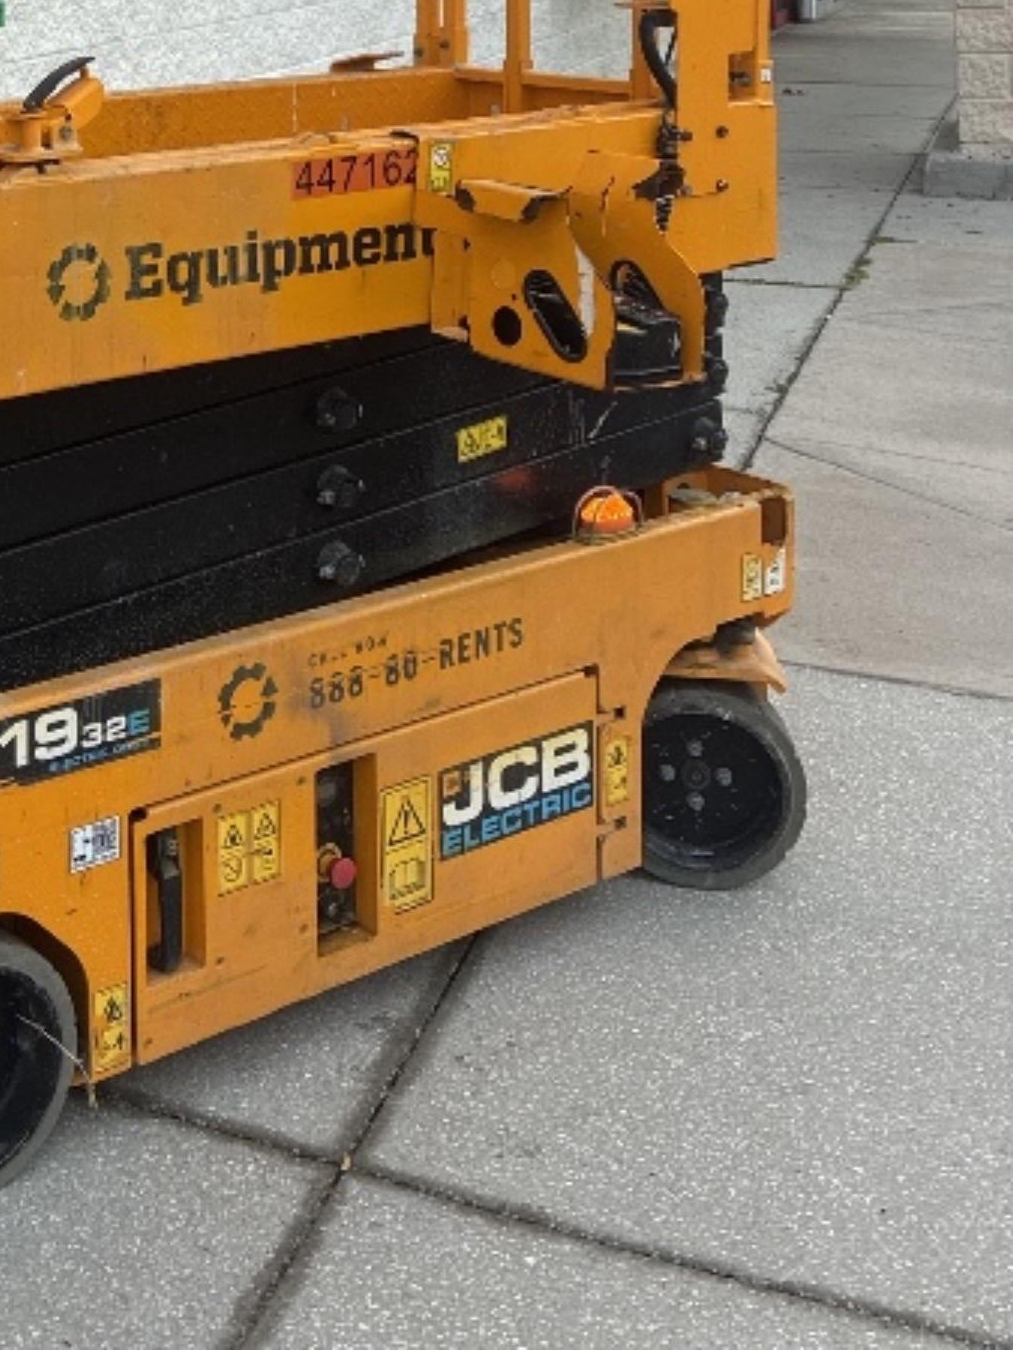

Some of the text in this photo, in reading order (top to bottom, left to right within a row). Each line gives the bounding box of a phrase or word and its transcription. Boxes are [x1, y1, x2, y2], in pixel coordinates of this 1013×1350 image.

[295, 149, 418, 196] 447162
[442, 728, 590, 826] JCB
[442, 782, 590, 856] ELECTRIC
